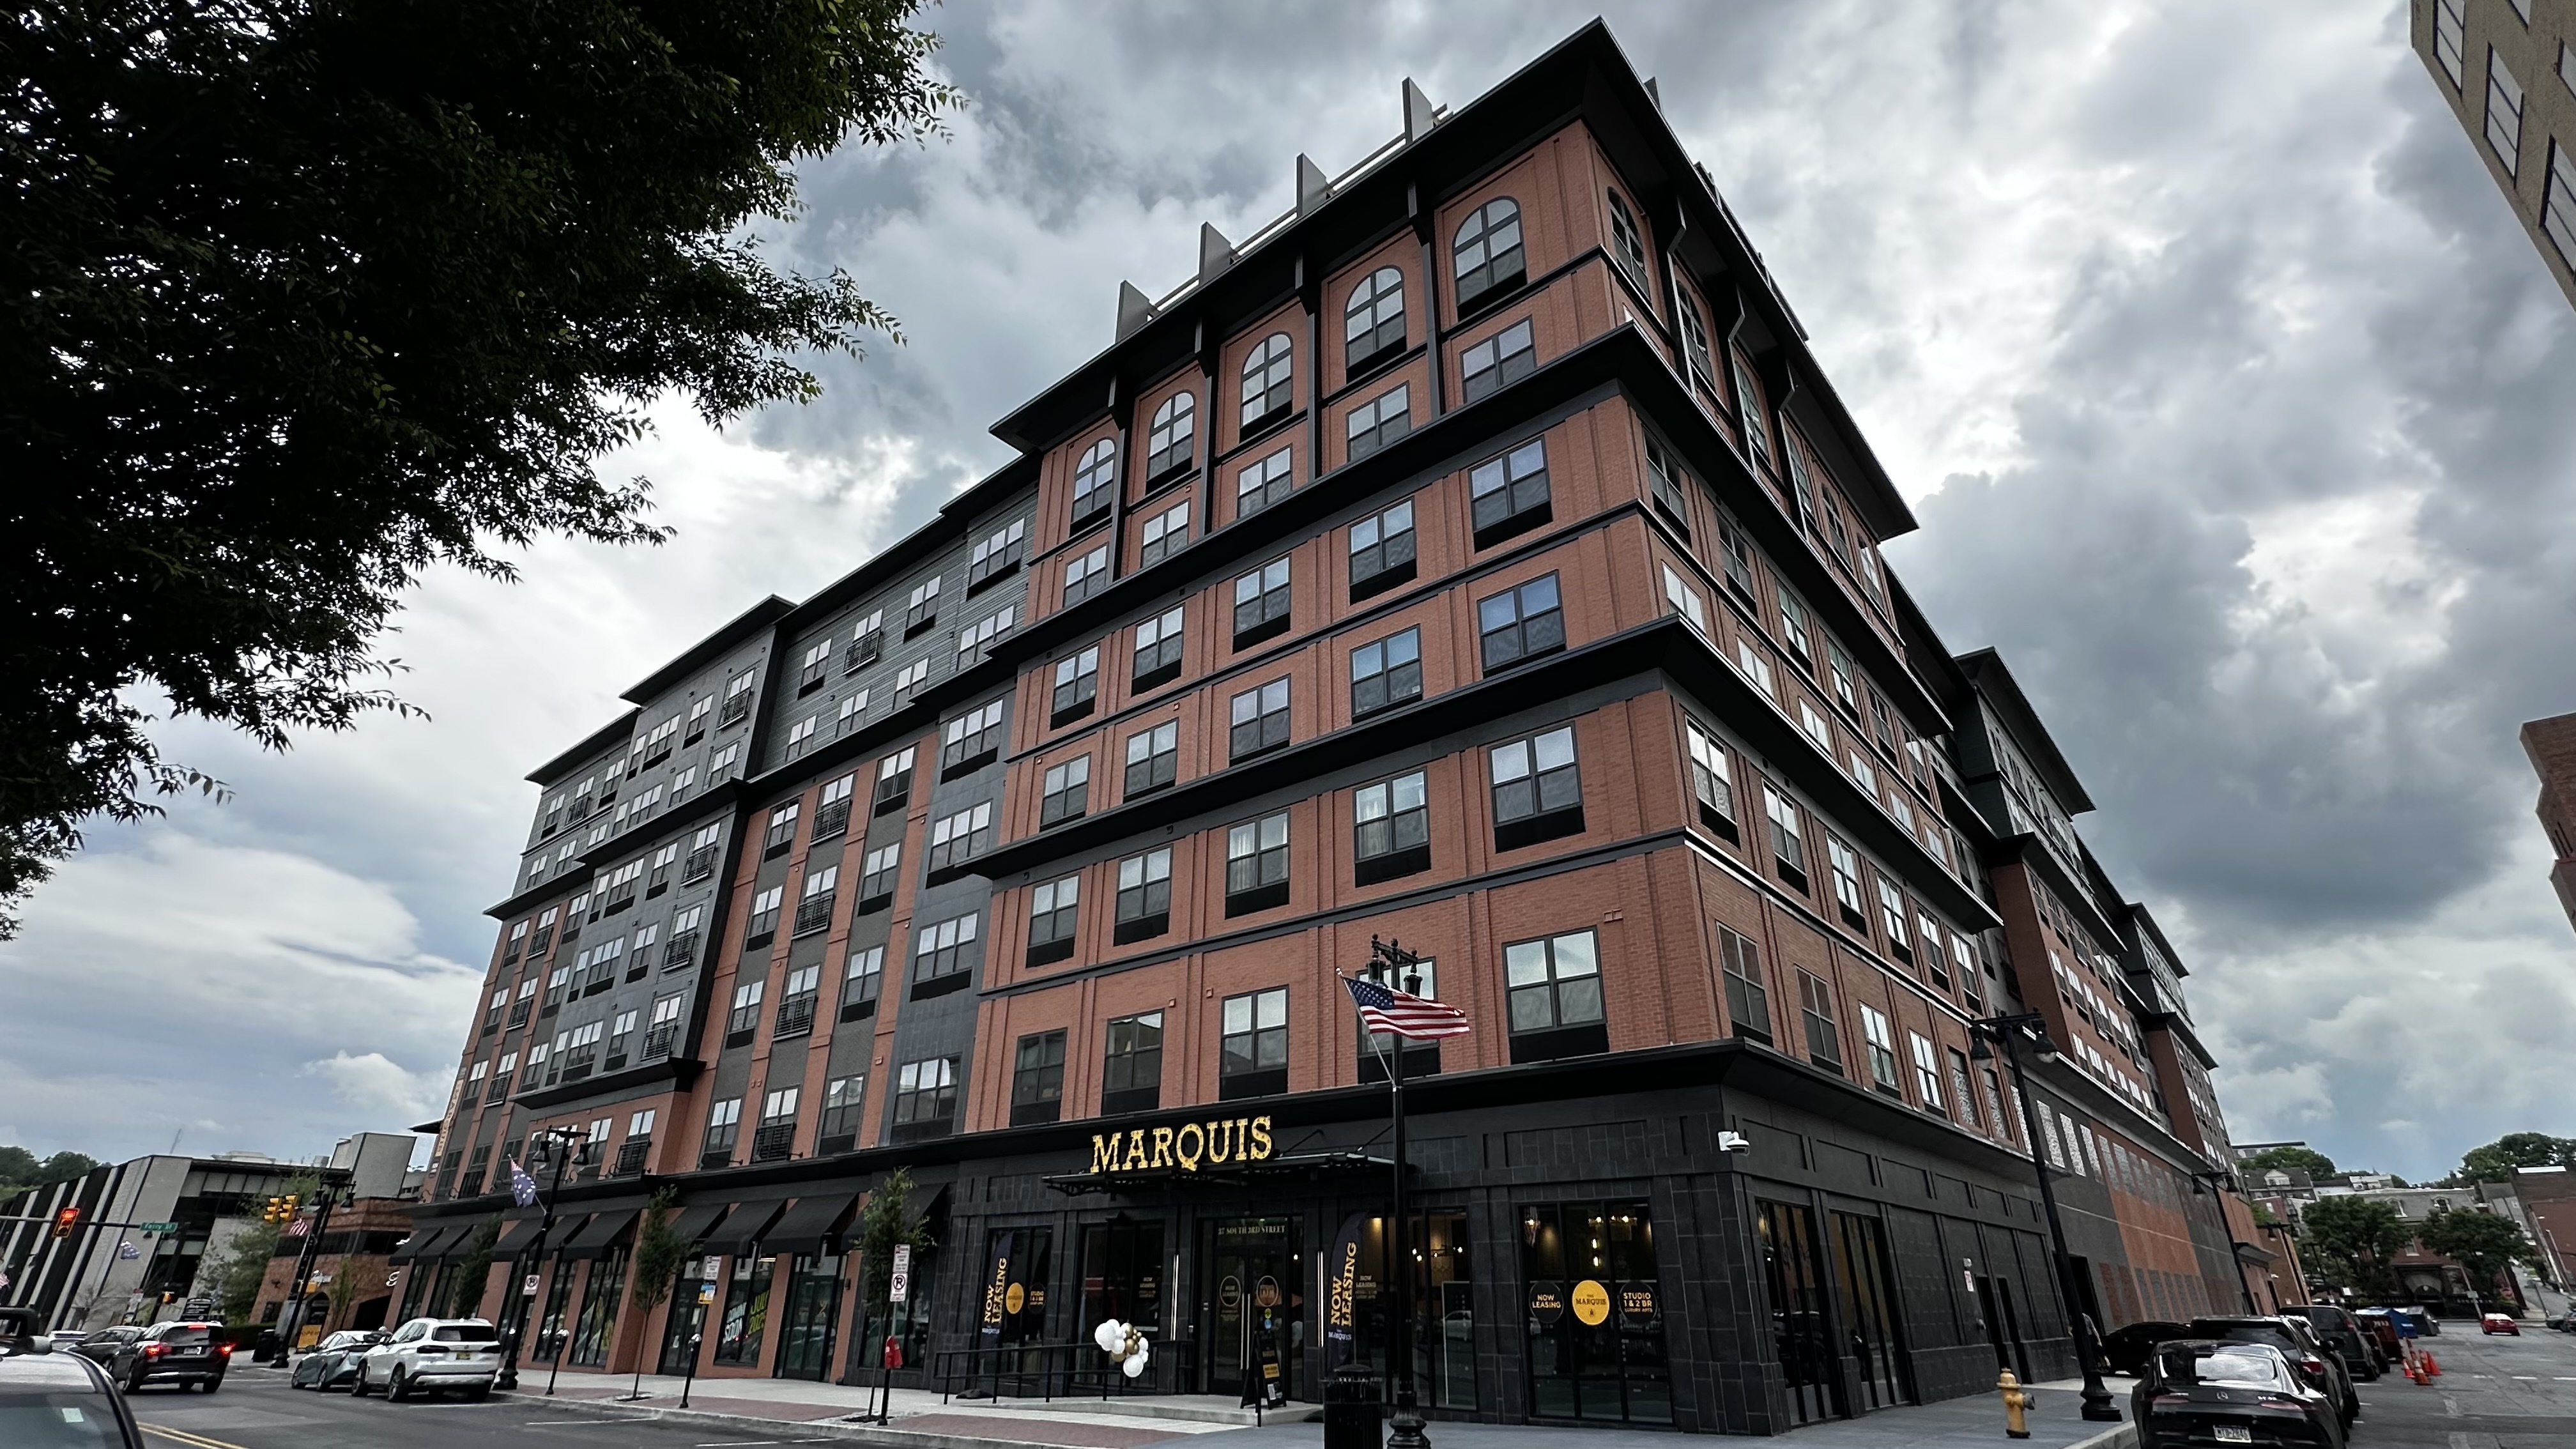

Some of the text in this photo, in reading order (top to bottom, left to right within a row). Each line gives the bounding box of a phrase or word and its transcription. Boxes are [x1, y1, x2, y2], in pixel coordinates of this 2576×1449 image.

[1090, 1116, 1271, 1172] MARQUIS
[1227, 1226, 1246, 1234] SOUTH
[984, 1285, 994, 1322] NOW
[991, 1257, 1008, 1323] LEASING
[1331, 1275, 1342, 1325] NOW
[1342, 1242, 1357, 1327] LEASING
